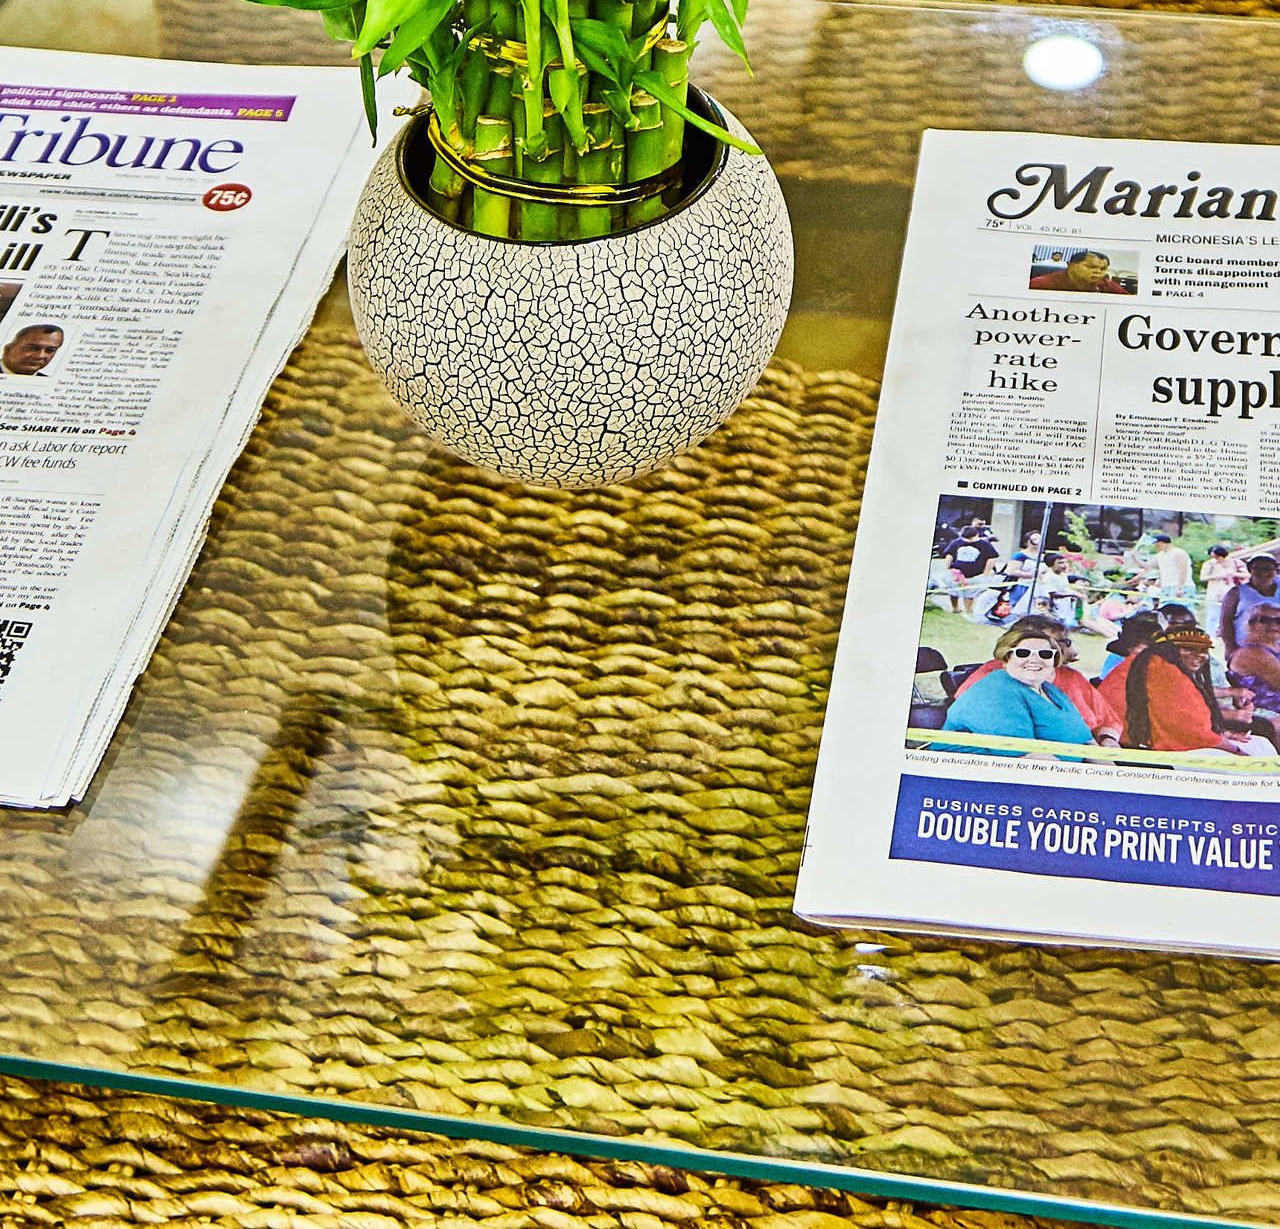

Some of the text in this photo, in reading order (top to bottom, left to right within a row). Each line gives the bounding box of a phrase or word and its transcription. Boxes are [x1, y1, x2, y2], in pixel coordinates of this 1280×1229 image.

[208, 190, 248, 205] 75¢
[1156, 234, 1258, 247] MICRONESIA'S
[1155, 254, 1279, 268] CUC board member
[1155, 266, 1280, 279] Torres disappointed
[1154, 277, 1270, 290] with management
[965, 303, 1096, 325] Another
[974, 329, 1081, 347] power-
[993, 352, 1058, 369] rate
[988, 370, 1058, 392] hike
[21, 424, 58, 433] SHARK
[61, 426, 79, 434] FIN
[99, 428, 126, 436] Page
[9, 440, 29, 452] ask
[31, 441, 68, 453] Labor
[69, 442, 88, 453] for
[89, 444, 127, 455] report
[20, 456, 41, 468] fee
[41, 456, 76, 468] funds
[972, 481, 1082, 496] CONTINUED ON PAGE 2
[19, 602, 42, 610] Page
[922, 797, 1022, 816] BUSINESS
[1031, 807, 1105, 825] CARDS,
[1115, 815, 1222, 833] RECEIPTS,
[917, 810, 1019, 849] DOUBLE
[1027, 821, 1097, 856] YOUR
[1104, 829, 1182, 864] PRINT
[1187, 835, 1273, 869] VALUE
